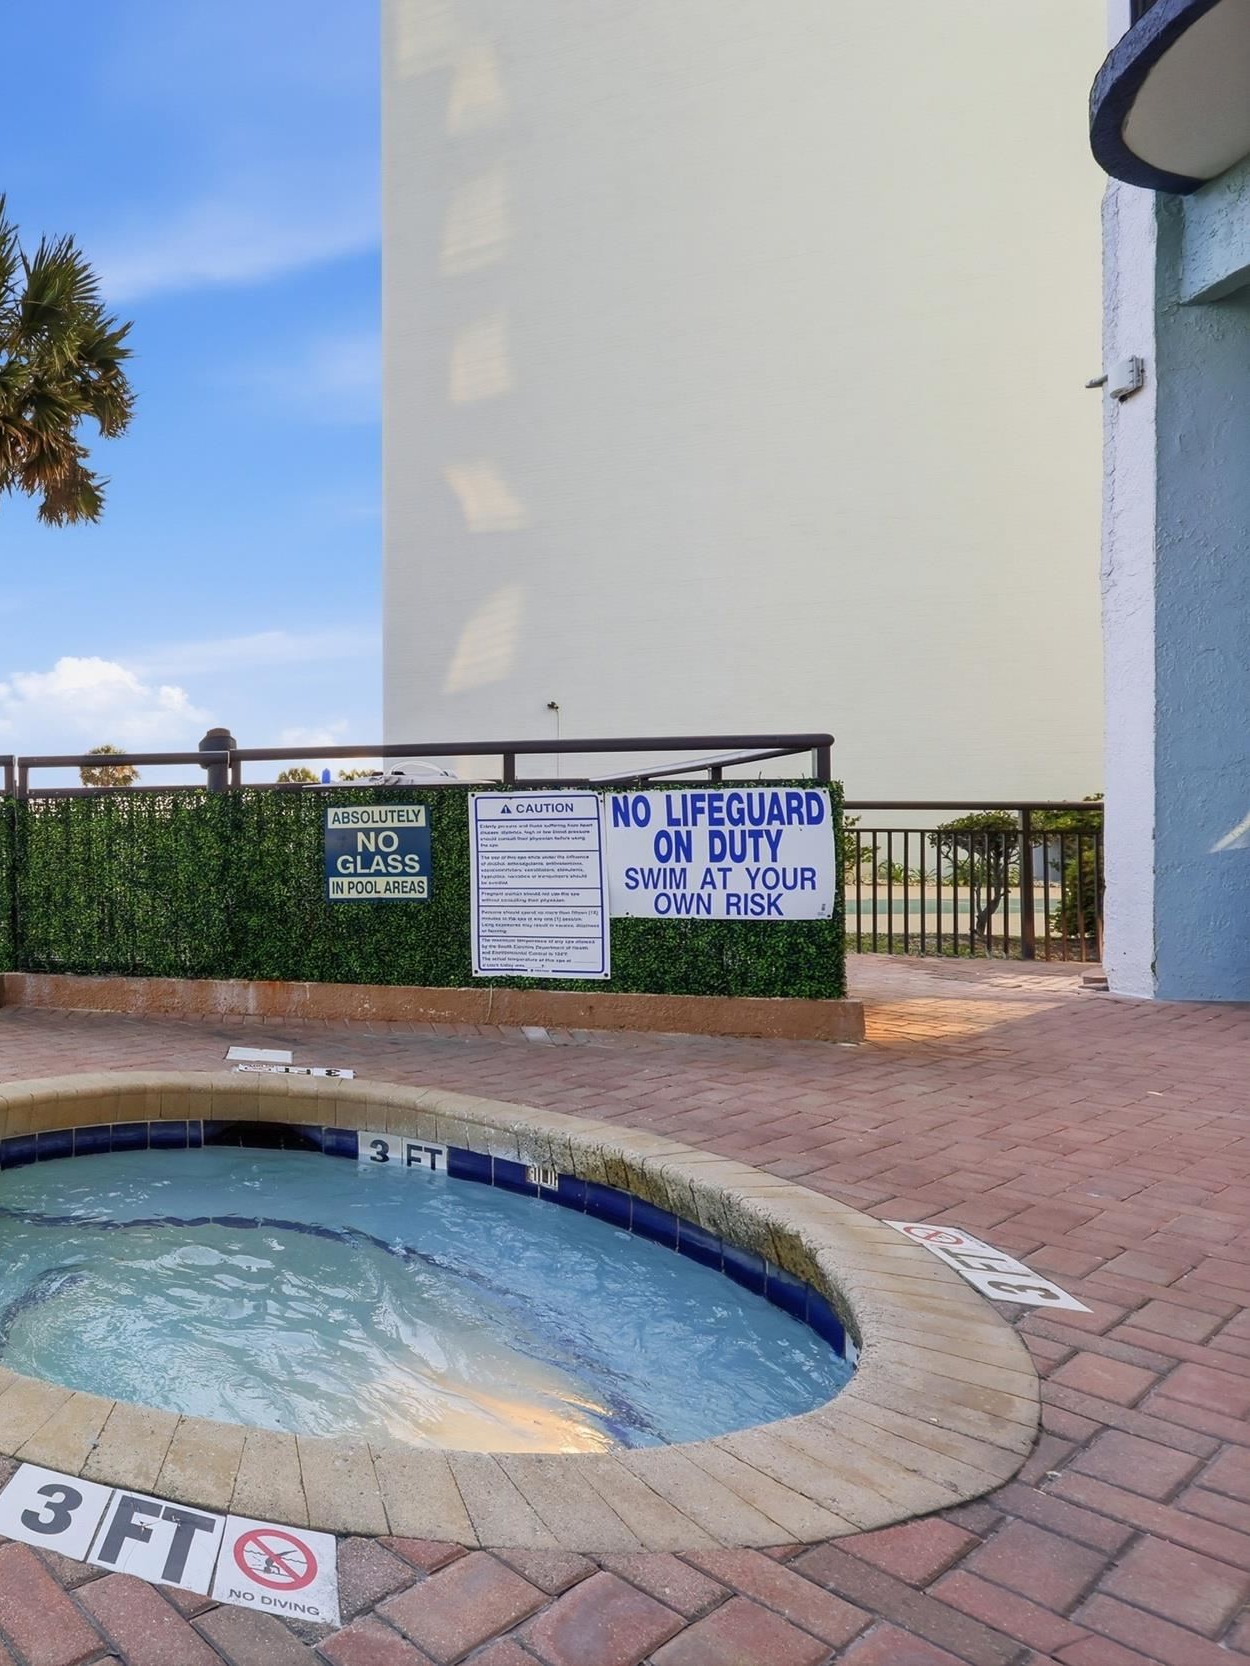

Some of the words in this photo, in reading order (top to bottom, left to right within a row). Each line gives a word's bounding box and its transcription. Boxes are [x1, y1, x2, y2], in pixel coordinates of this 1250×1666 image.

[332, 809, 420, 824] ABSOLUTELY
[516, 803, 574, 813] CAUTION
[612, 795, 650, 827] NO
[666, 792, 824, 827] LIFEGUARD
[357, 831, 399, 852] NO
[654, 830, 692, 863] ON
[709, 829, 783, 863] DUTY
[336, 854, 420, 874] GLASS
[332, 881, 343, 894] IN
[348, 881, 380, 894] POOL
[384, 881, 425, 894] AREAS
[625, 867, 687, 890] SWIM
[700, 867, 732, 890] AT
[745, 867, 816, 890] YOUR
[654, 893, 711, 915] OWN
[726, 893, 784, 915] RISK
[369, 1139, 390, 1163] 3
[406, 1144, 443, 1171] FT
[939, 1247, 1032, 1278] FT
[987, 1280, 1060, 1300] 3
[20, 1483, 83, 1535] 3
[97, 1494, 216, 1585] FT
[229, 1588, 255, 1602] NO
[261, 1594, 321, 1616] DIVING
